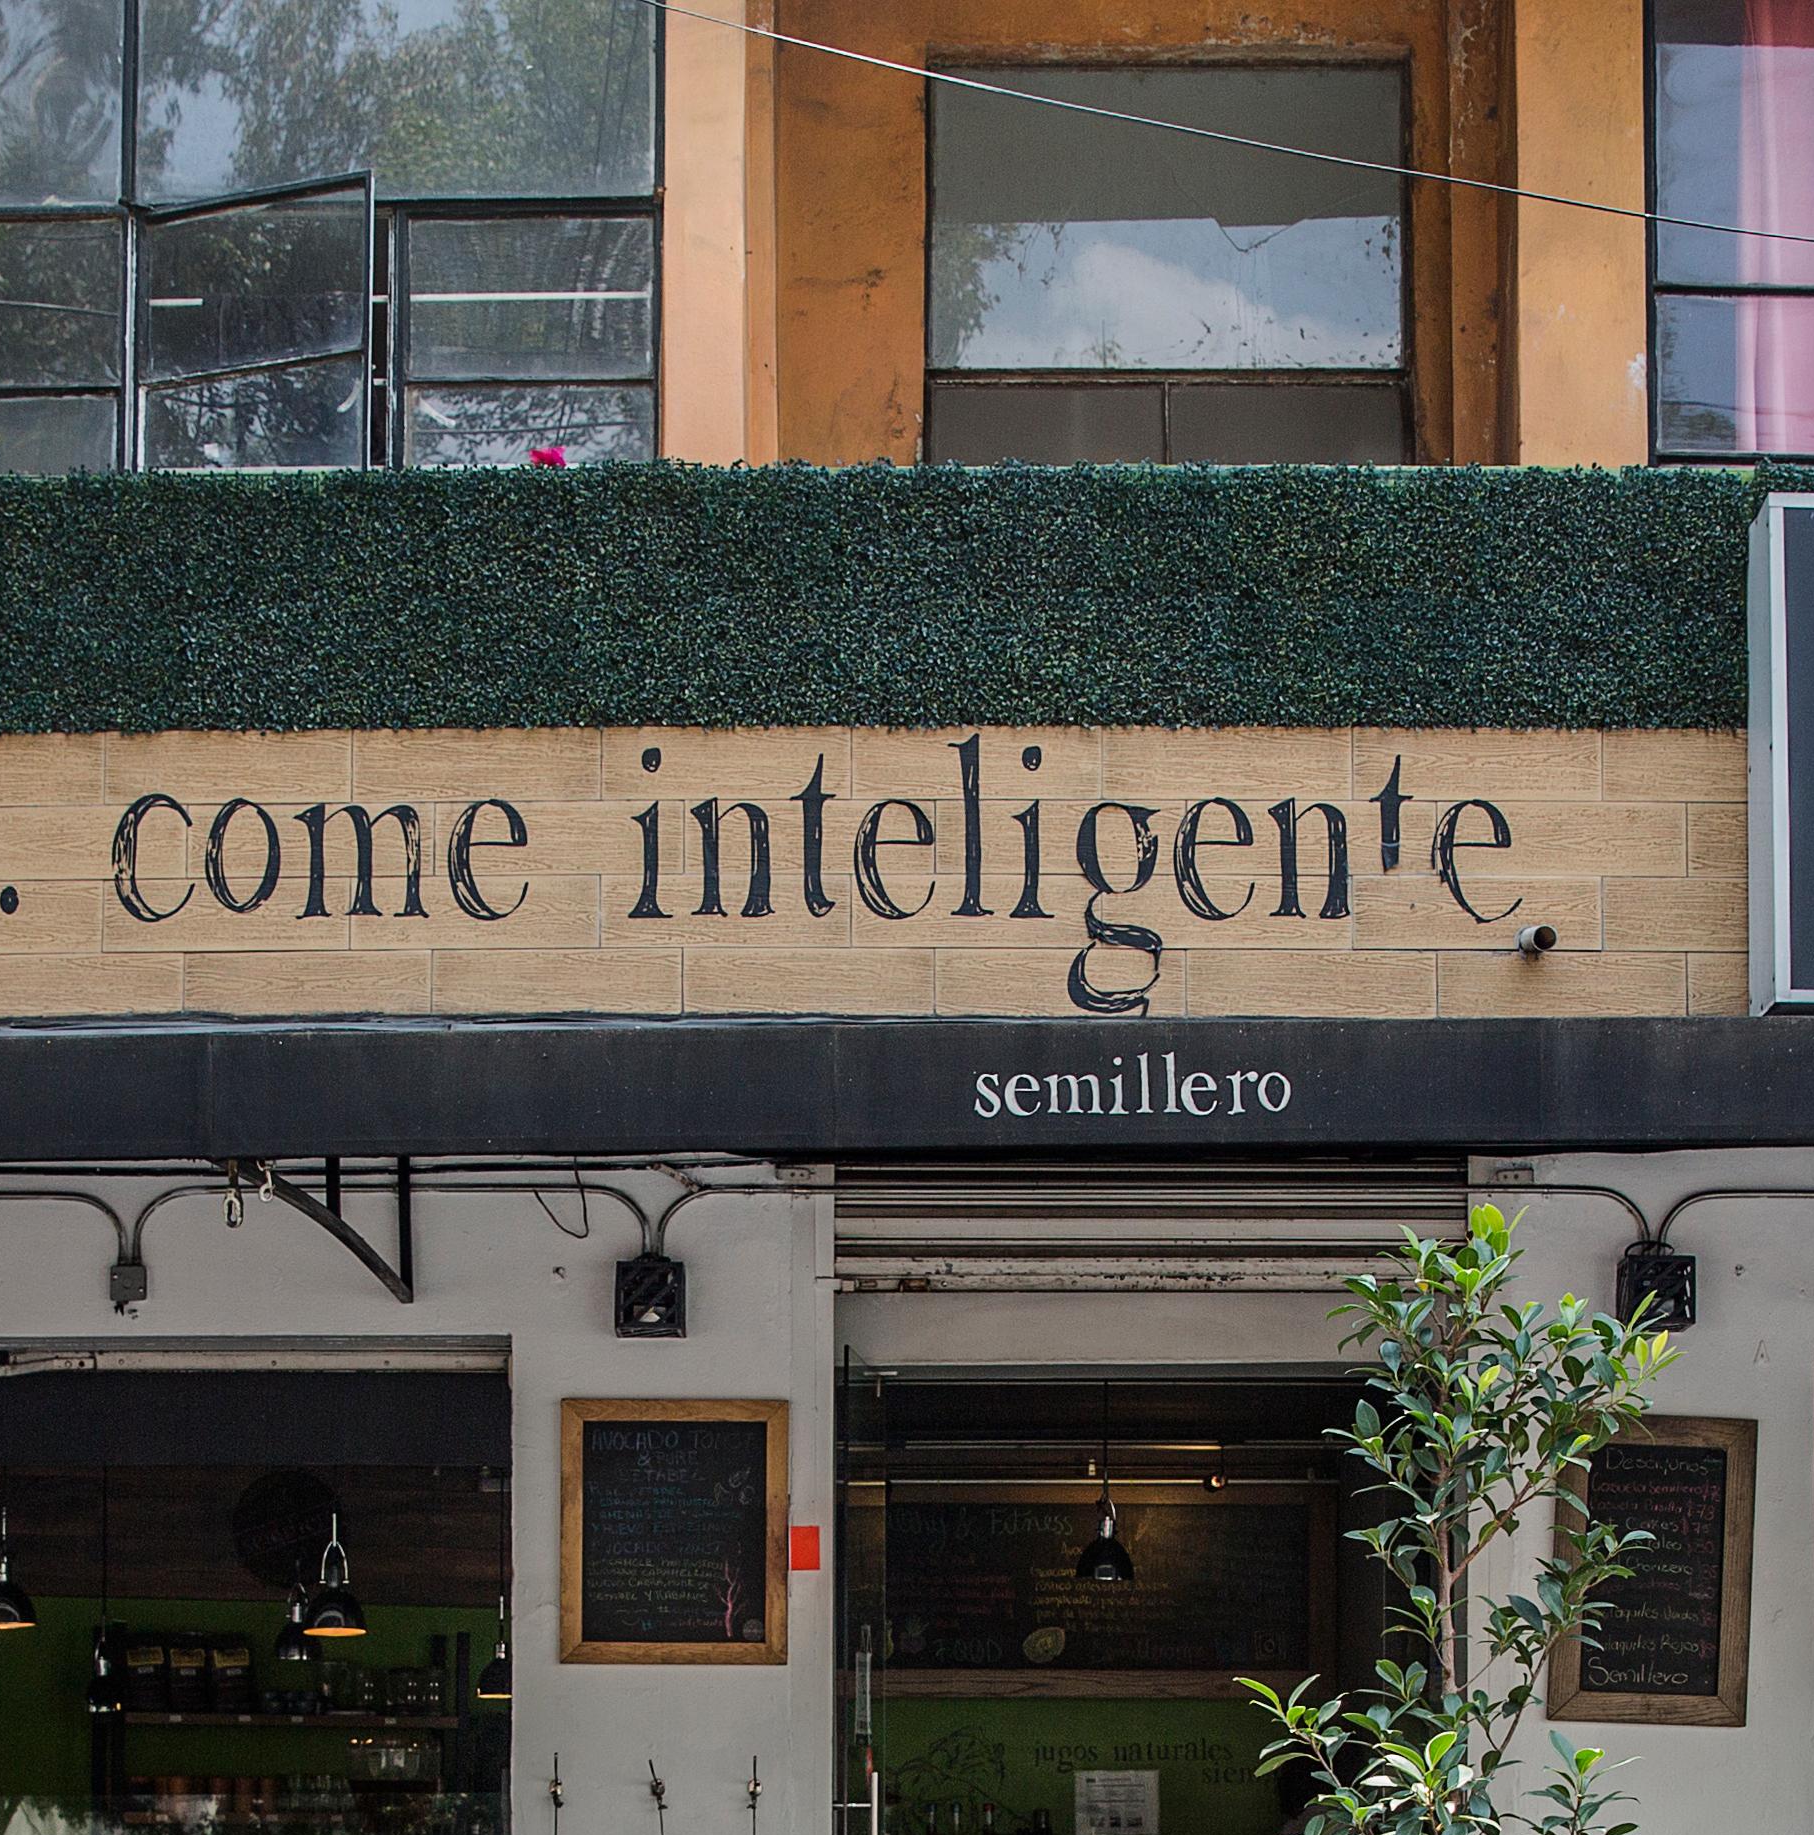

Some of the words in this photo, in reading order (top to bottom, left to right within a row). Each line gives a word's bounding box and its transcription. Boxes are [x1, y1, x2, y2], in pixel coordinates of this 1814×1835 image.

[111, 793, 529, 923] come
[626, 733, 1524, 1018] inteligente
[974, 1052, 1292, 1118] semillero
[1587, 1656, 1689, 1687] Semillero
[1035, 1741, 1099, 1774] jugos
[1113, 1737, 1234, 1763] naturales
